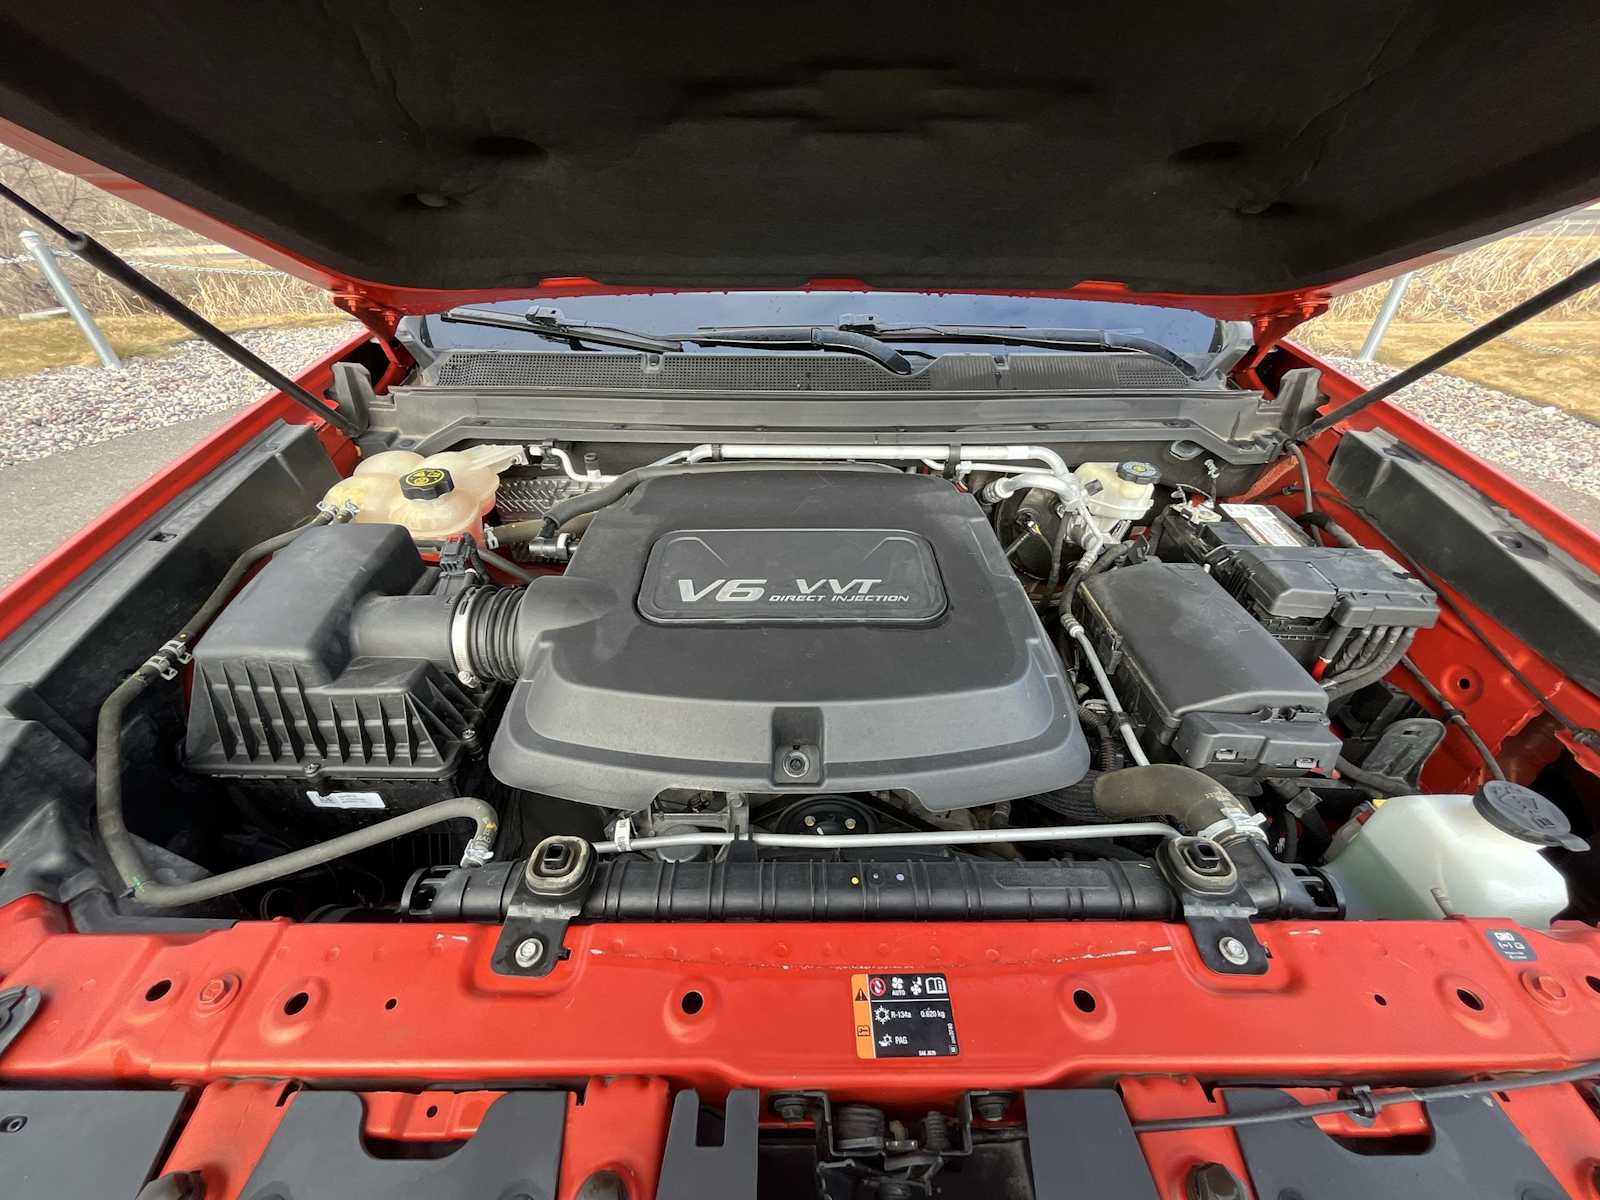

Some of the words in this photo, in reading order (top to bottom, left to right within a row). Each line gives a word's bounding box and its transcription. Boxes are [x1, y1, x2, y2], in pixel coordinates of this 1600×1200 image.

[678, 579, 767, 602] V6
[795, 579, 882, 594] VVT
[894, 1036, 908, 1044] PAG
